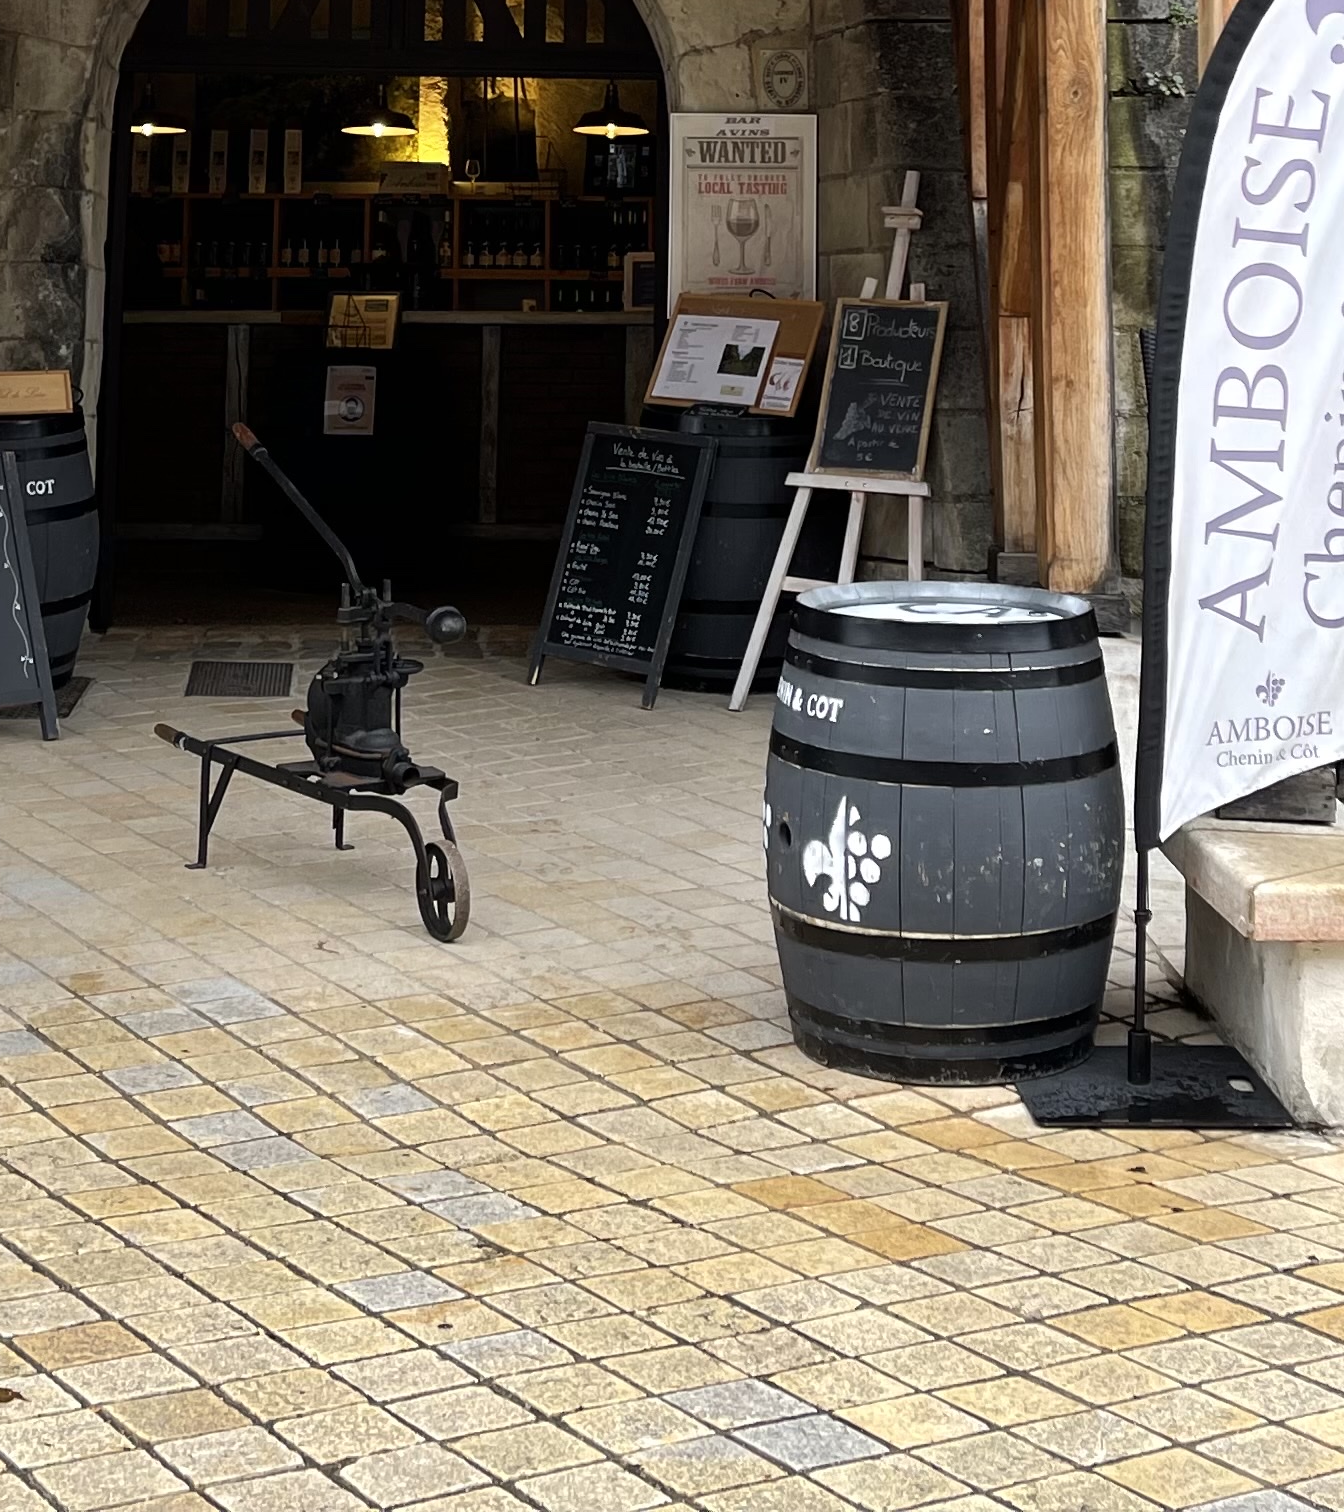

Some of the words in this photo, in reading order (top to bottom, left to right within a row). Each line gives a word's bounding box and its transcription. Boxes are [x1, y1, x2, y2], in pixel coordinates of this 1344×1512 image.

[698, 141, 786, 164] WANTED
[698, 182, 733, 194] LOCAL
[738, 183, 787, 195] TASTING
[849, 313, 860, 332] 8
[859, 349, 923, 383] Boutique
[1197, 85, 1332, 643] AMBOISE
[880, 392, 922, 408] VENTE
[26, 478, 55, 495] COT
[806, 693, 844, 723] COT
[1206, 710, 1333, 747] AMBOISE
[1216, 748, 1273, 768] Chenin
[1290, 742, 1320, 760] Côt
